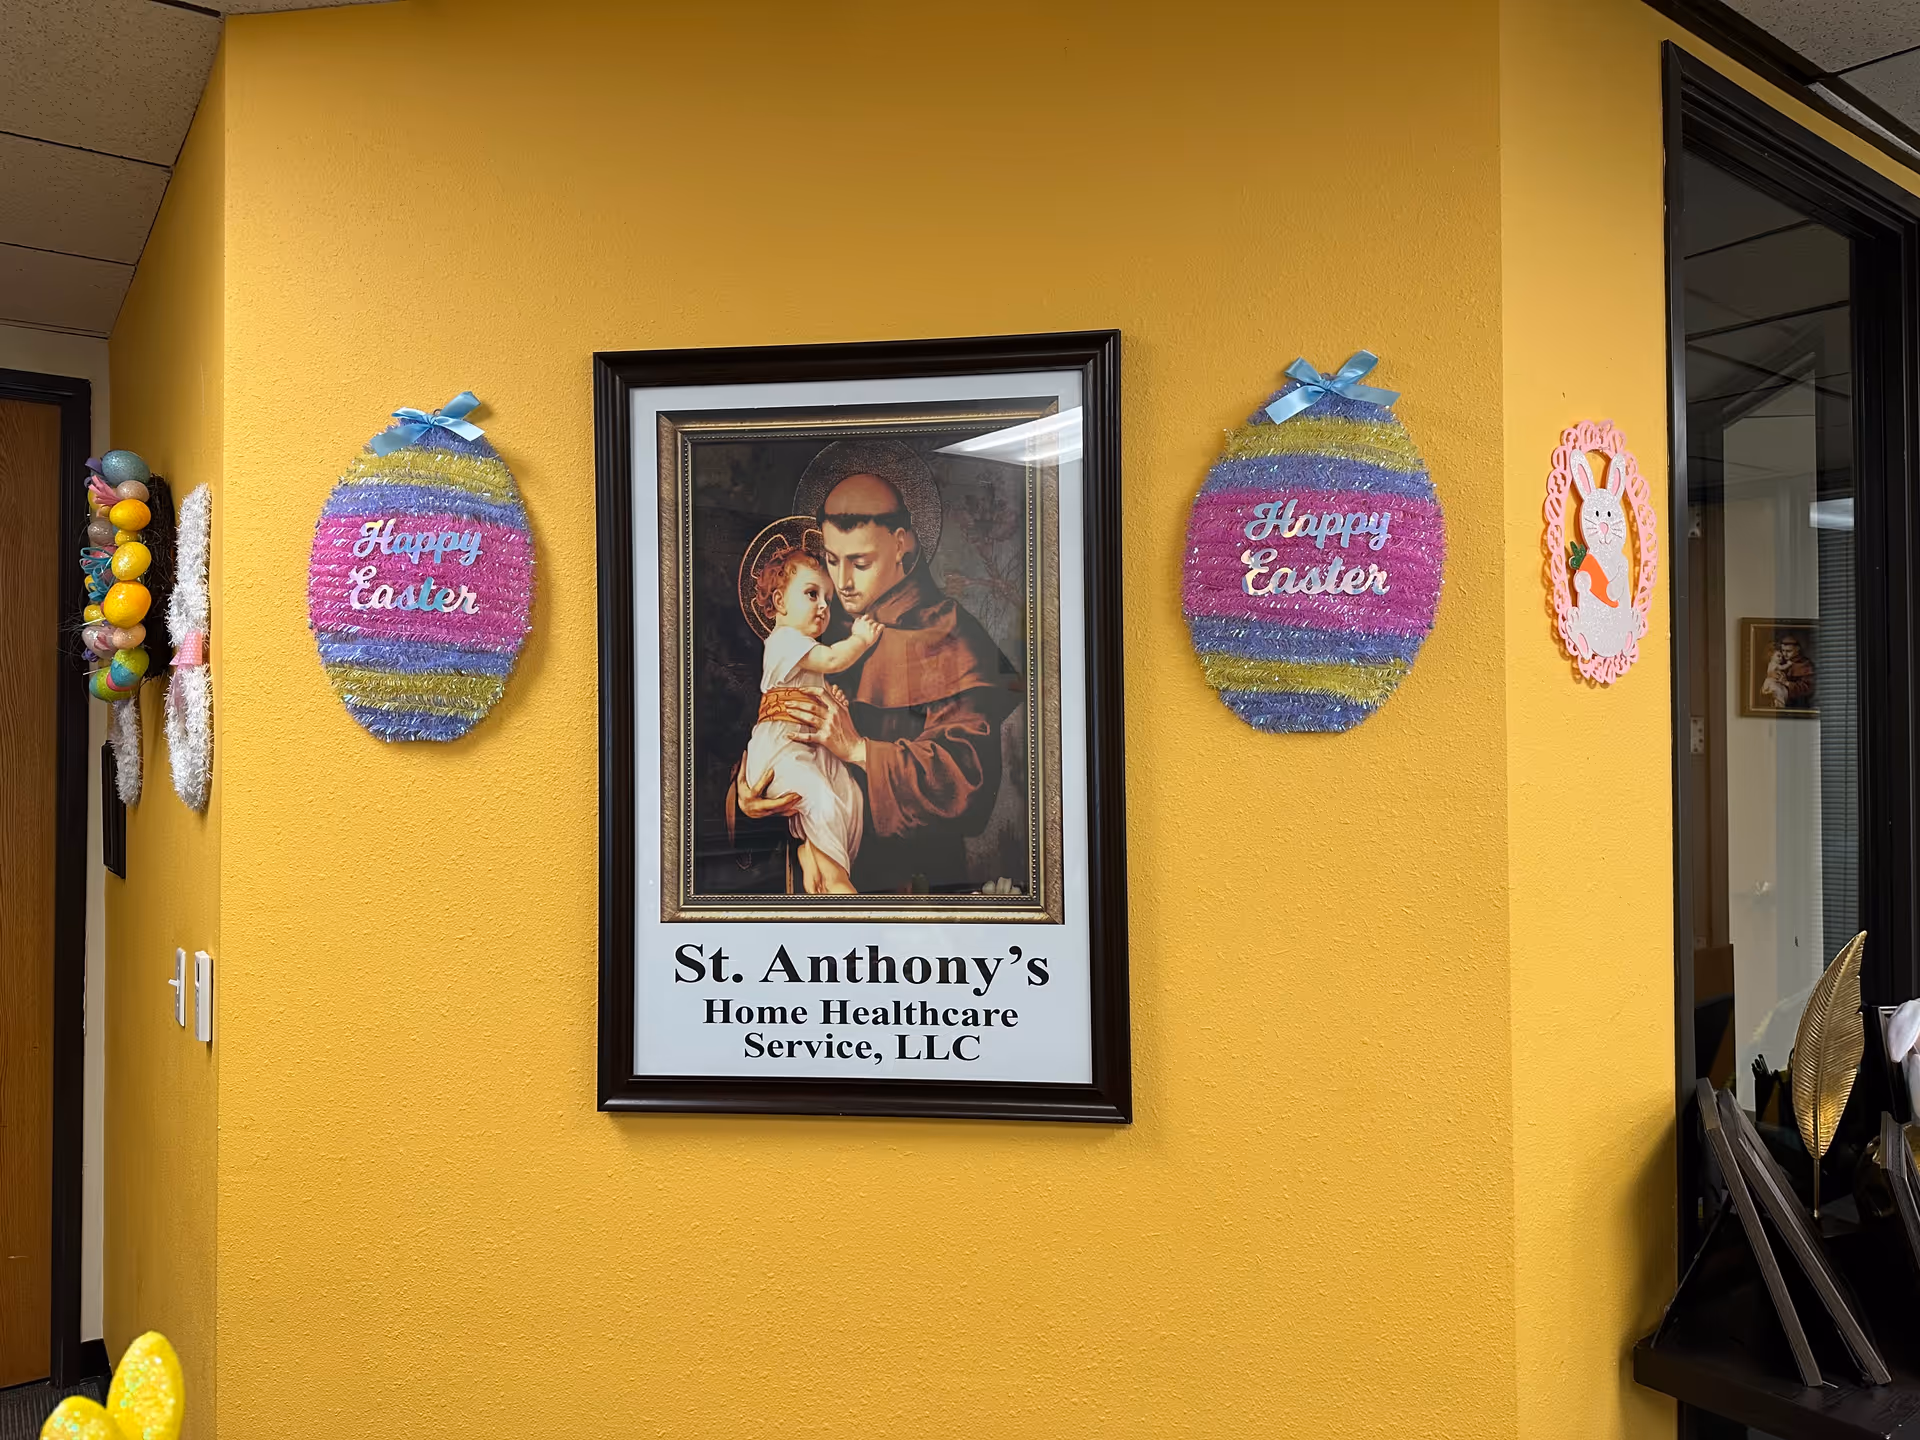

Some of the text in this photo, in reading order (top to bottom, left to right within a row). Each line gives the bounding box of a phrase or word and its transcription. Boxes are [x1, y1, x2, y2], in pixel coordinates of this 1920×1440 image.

[353, 518, 483, 566] Happy
[1244, 499, 1391, 550] Happy
[349, 565, 479, 614] Easter
[1241, 548, 1391, 595] Easter
[674, 943, 1050, 997] St. Anthony’s
[703, 998, 1019, 1028] Home Healthcare
[744, 1032, 981, 1066] Service, LLC
